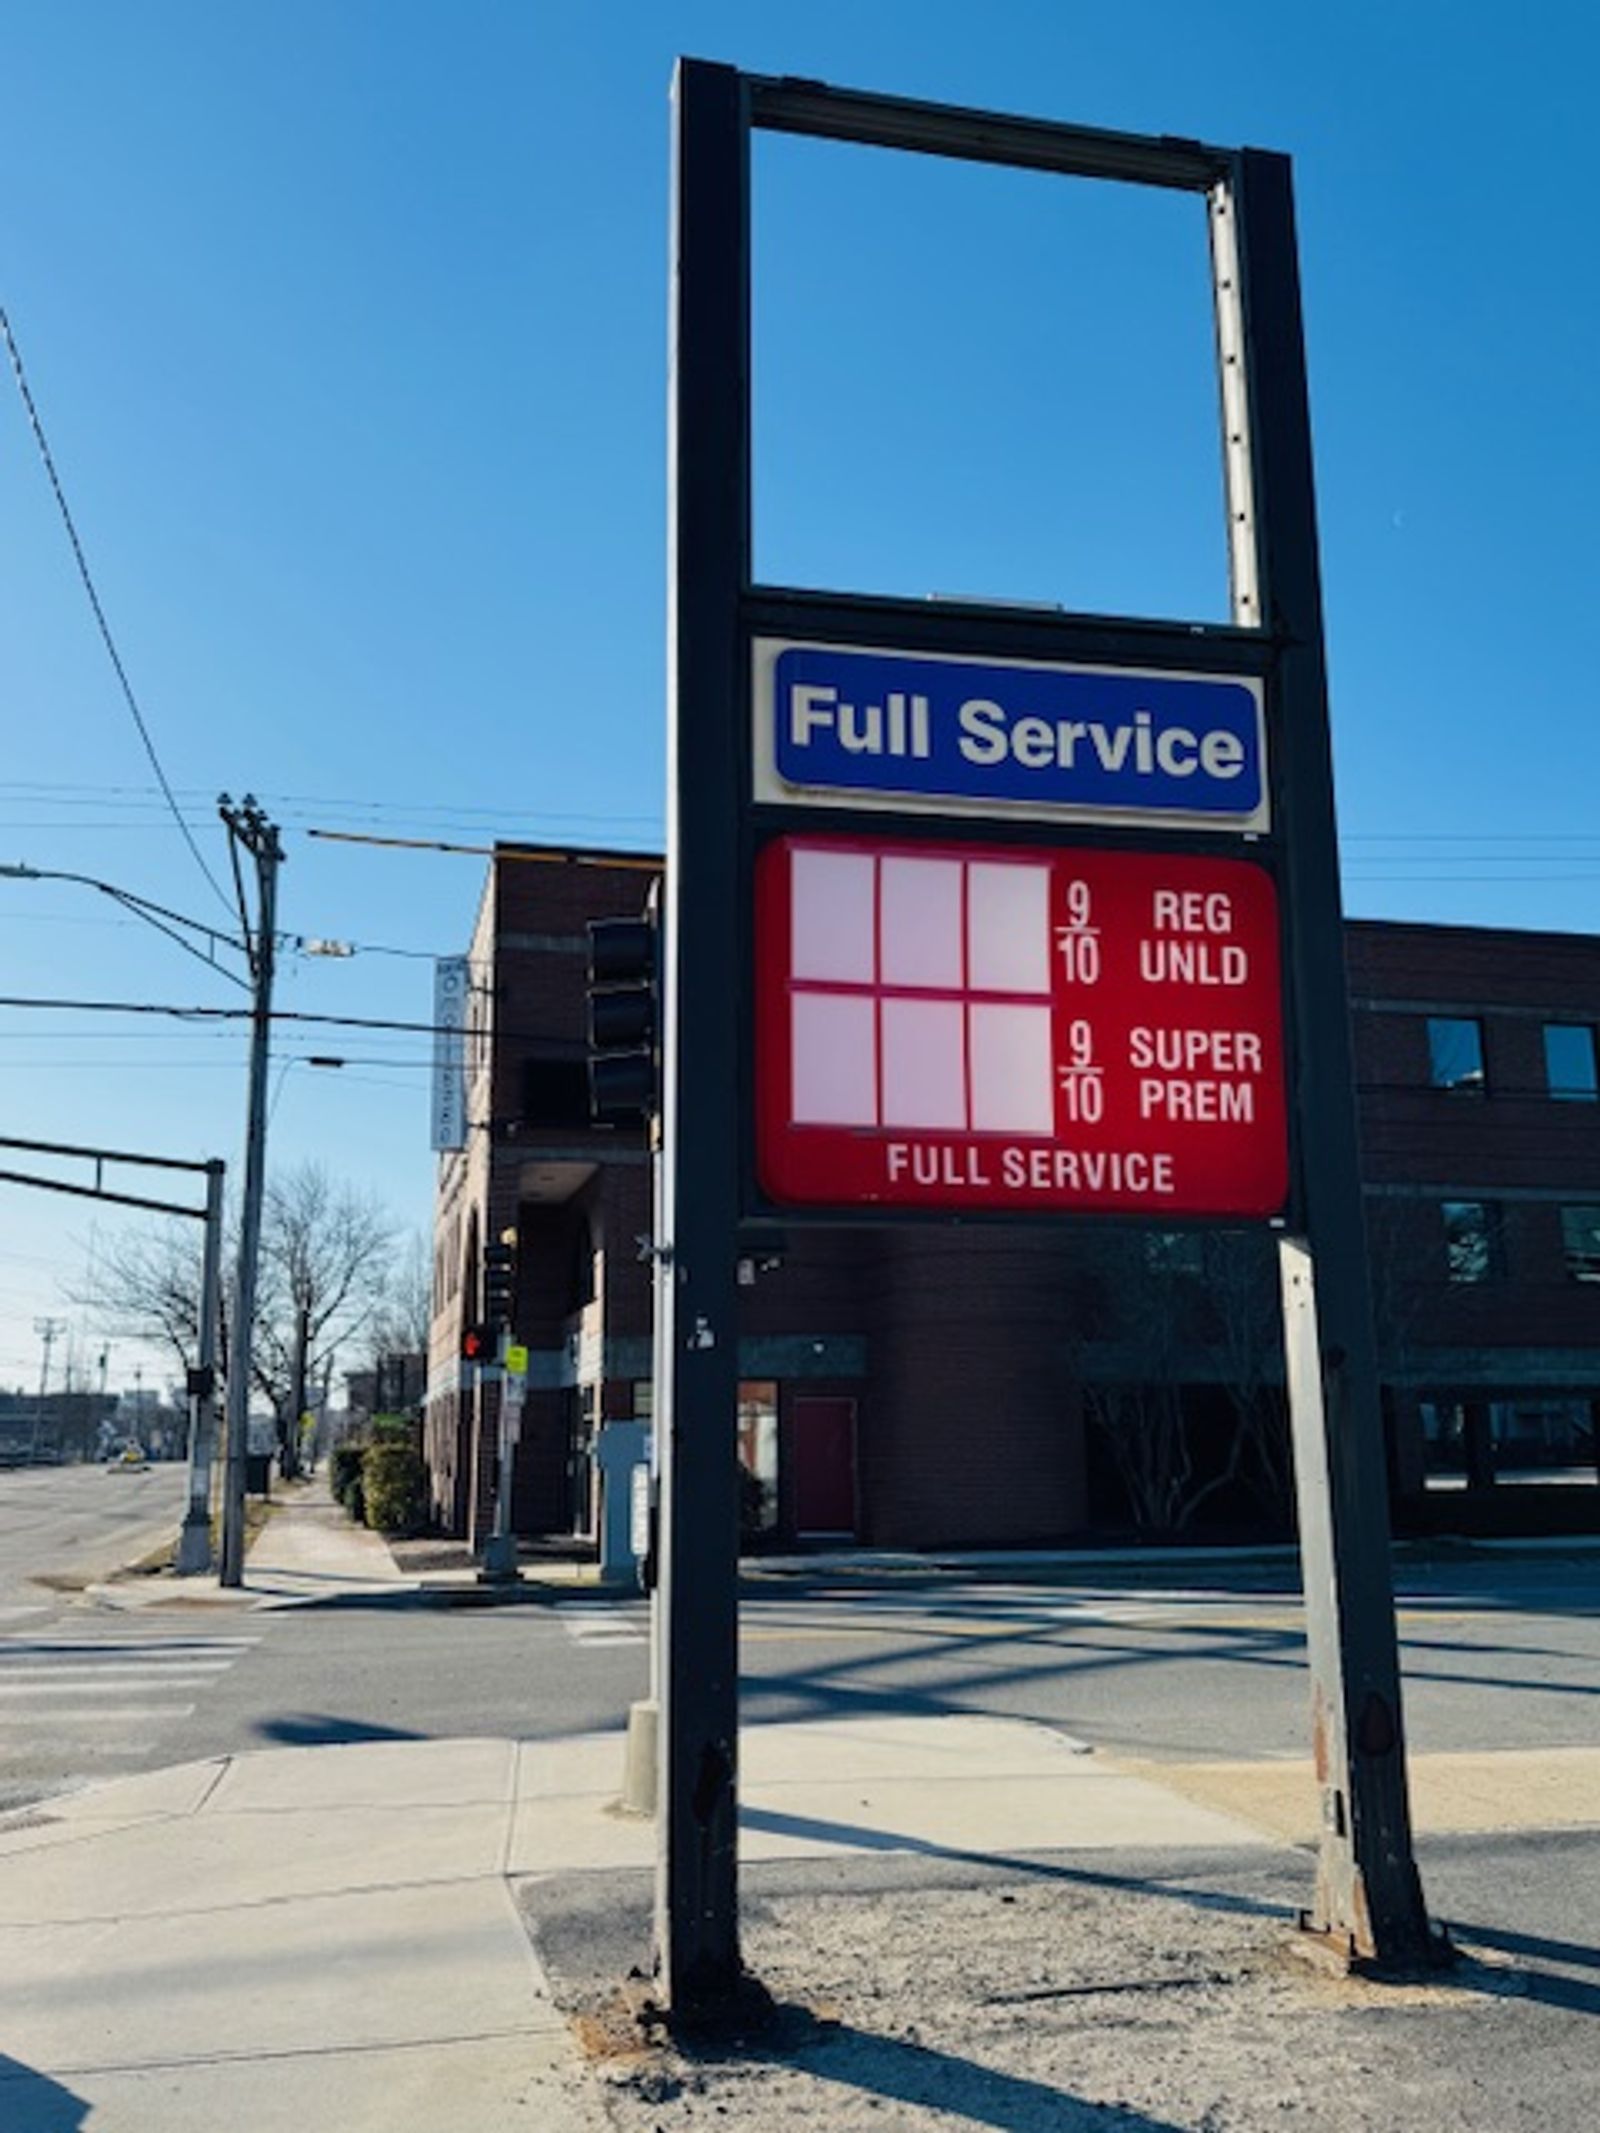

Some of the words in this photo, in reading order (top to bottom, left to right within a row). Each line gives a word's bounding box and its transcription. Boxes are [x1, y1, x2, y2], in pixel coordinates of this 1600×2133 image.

[790, 684, 929, 758] Full
[957, 699, 1245, 779] Service
[1067, 880, 1090, 927] 9
[1153, 891, 1232, 933] REG
[1058, 934, 1100, 985] 10
[1139, 941, 1248, 986] UNLD
[1069, 1020, 1093, 1066] 9
[1129, 1027, 1262, 1073] SUPER
[1060, 1075, 1103, 1123] 10
[1139, 1079, 1254, 1122] PREM
[887, 1144, 990, 1186] FULL
[1002, 1147, 1175, 1193] SERVICE
